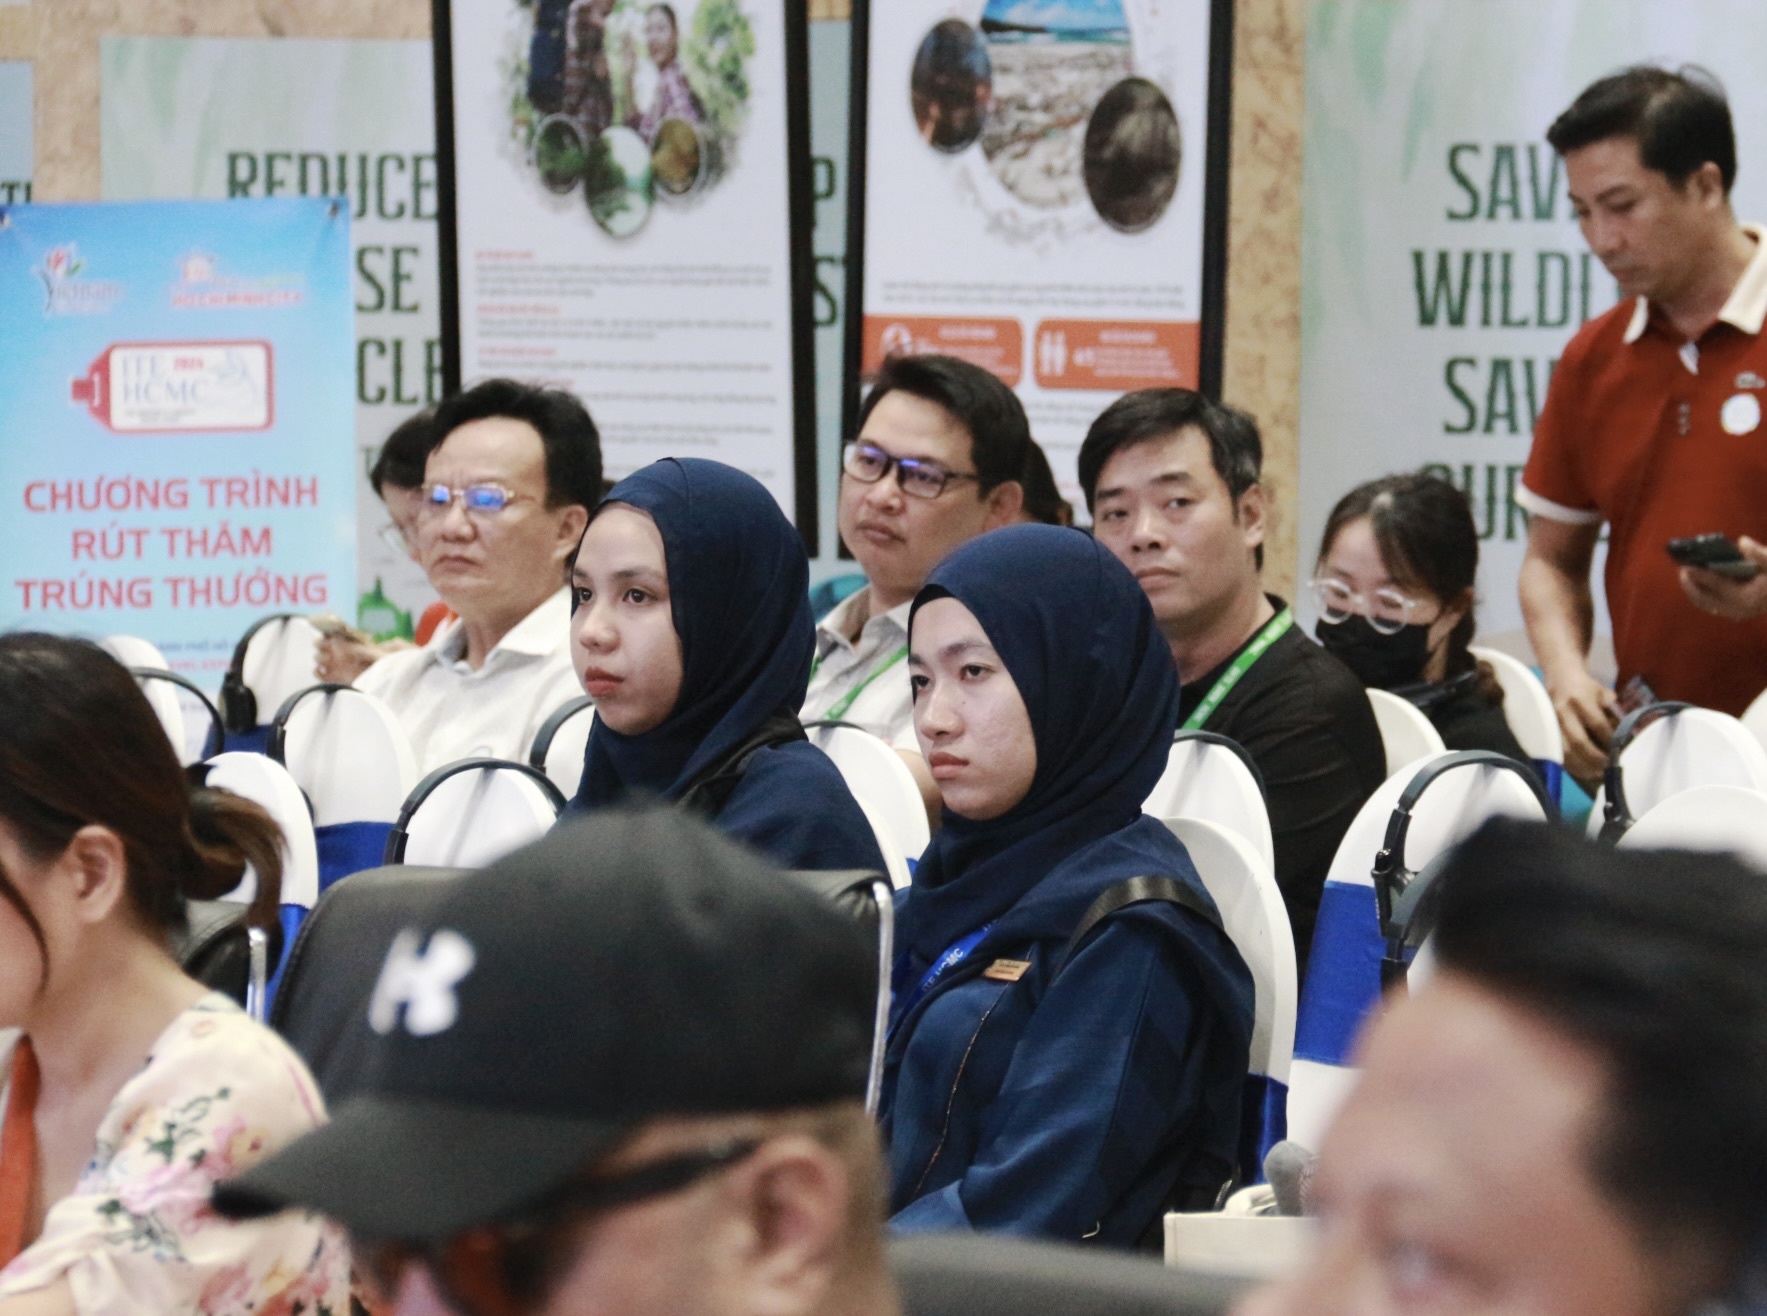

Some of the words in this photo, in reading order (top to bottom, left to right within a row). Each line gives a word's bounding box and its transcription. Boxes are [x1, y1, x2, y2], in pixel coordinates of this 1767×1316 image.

[1445, 143, 1578, 221] SAV
[23, 474, 190, 512] CHƯƠNG
[201, 470, 319, 508] TRÌNH
[71, 520, 151, 561] RÚT
[160, 519, 273, 559] THĂM
[14, 570, 153, 611] TRÚNG
